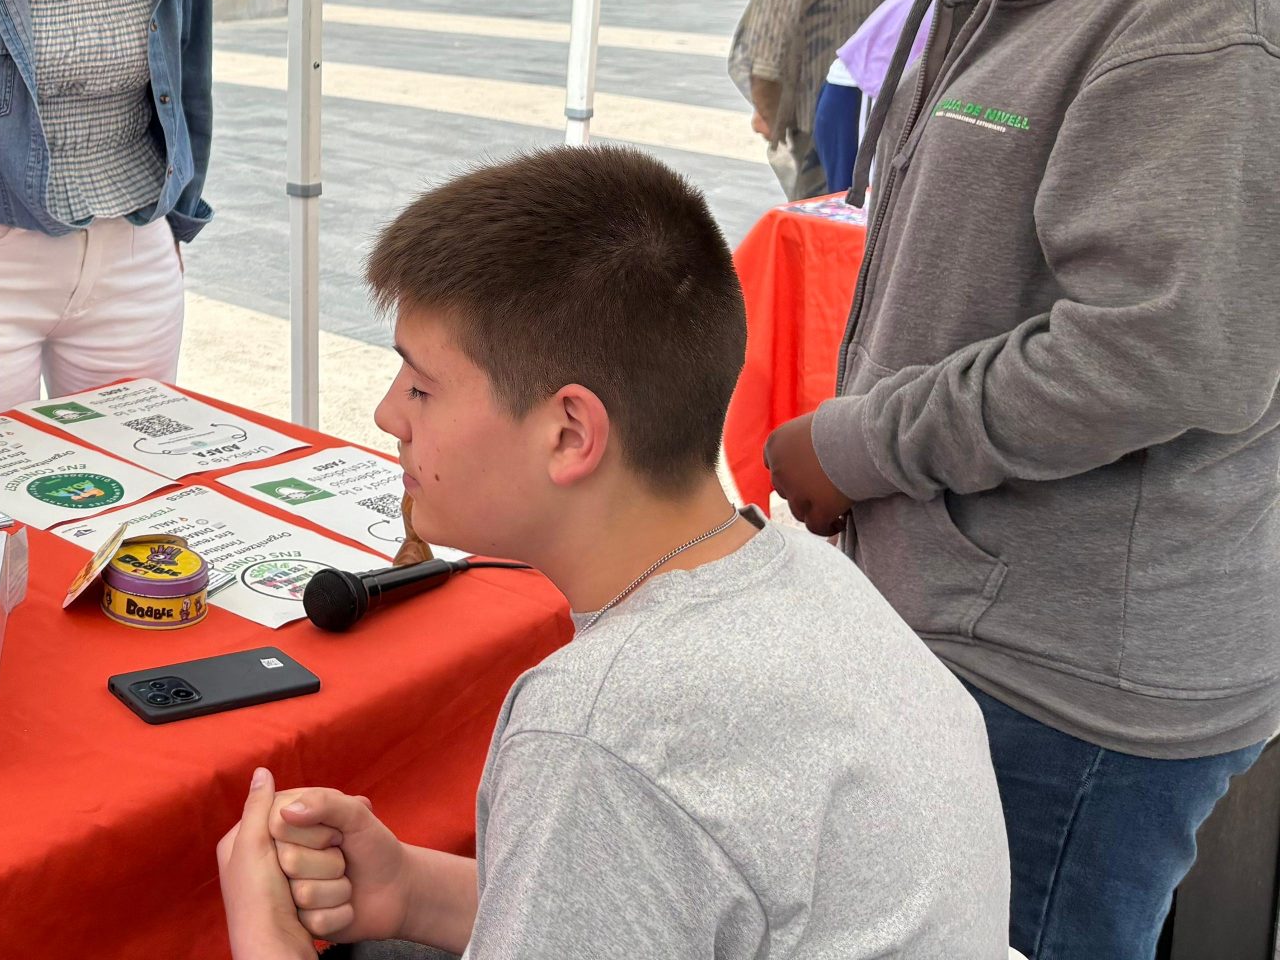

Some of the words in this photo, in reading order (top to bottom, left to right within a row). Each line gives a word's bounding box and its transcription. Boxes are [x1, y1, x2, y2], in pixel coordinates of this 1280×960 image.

[191, 443, 241, 458] ADAFA
[148, 520, 179, 531] HALL
[214, 530, 235, 540] Ens
[233, 531, 292, 555] Organitzem
[268, 551, 302, 559] ENS
